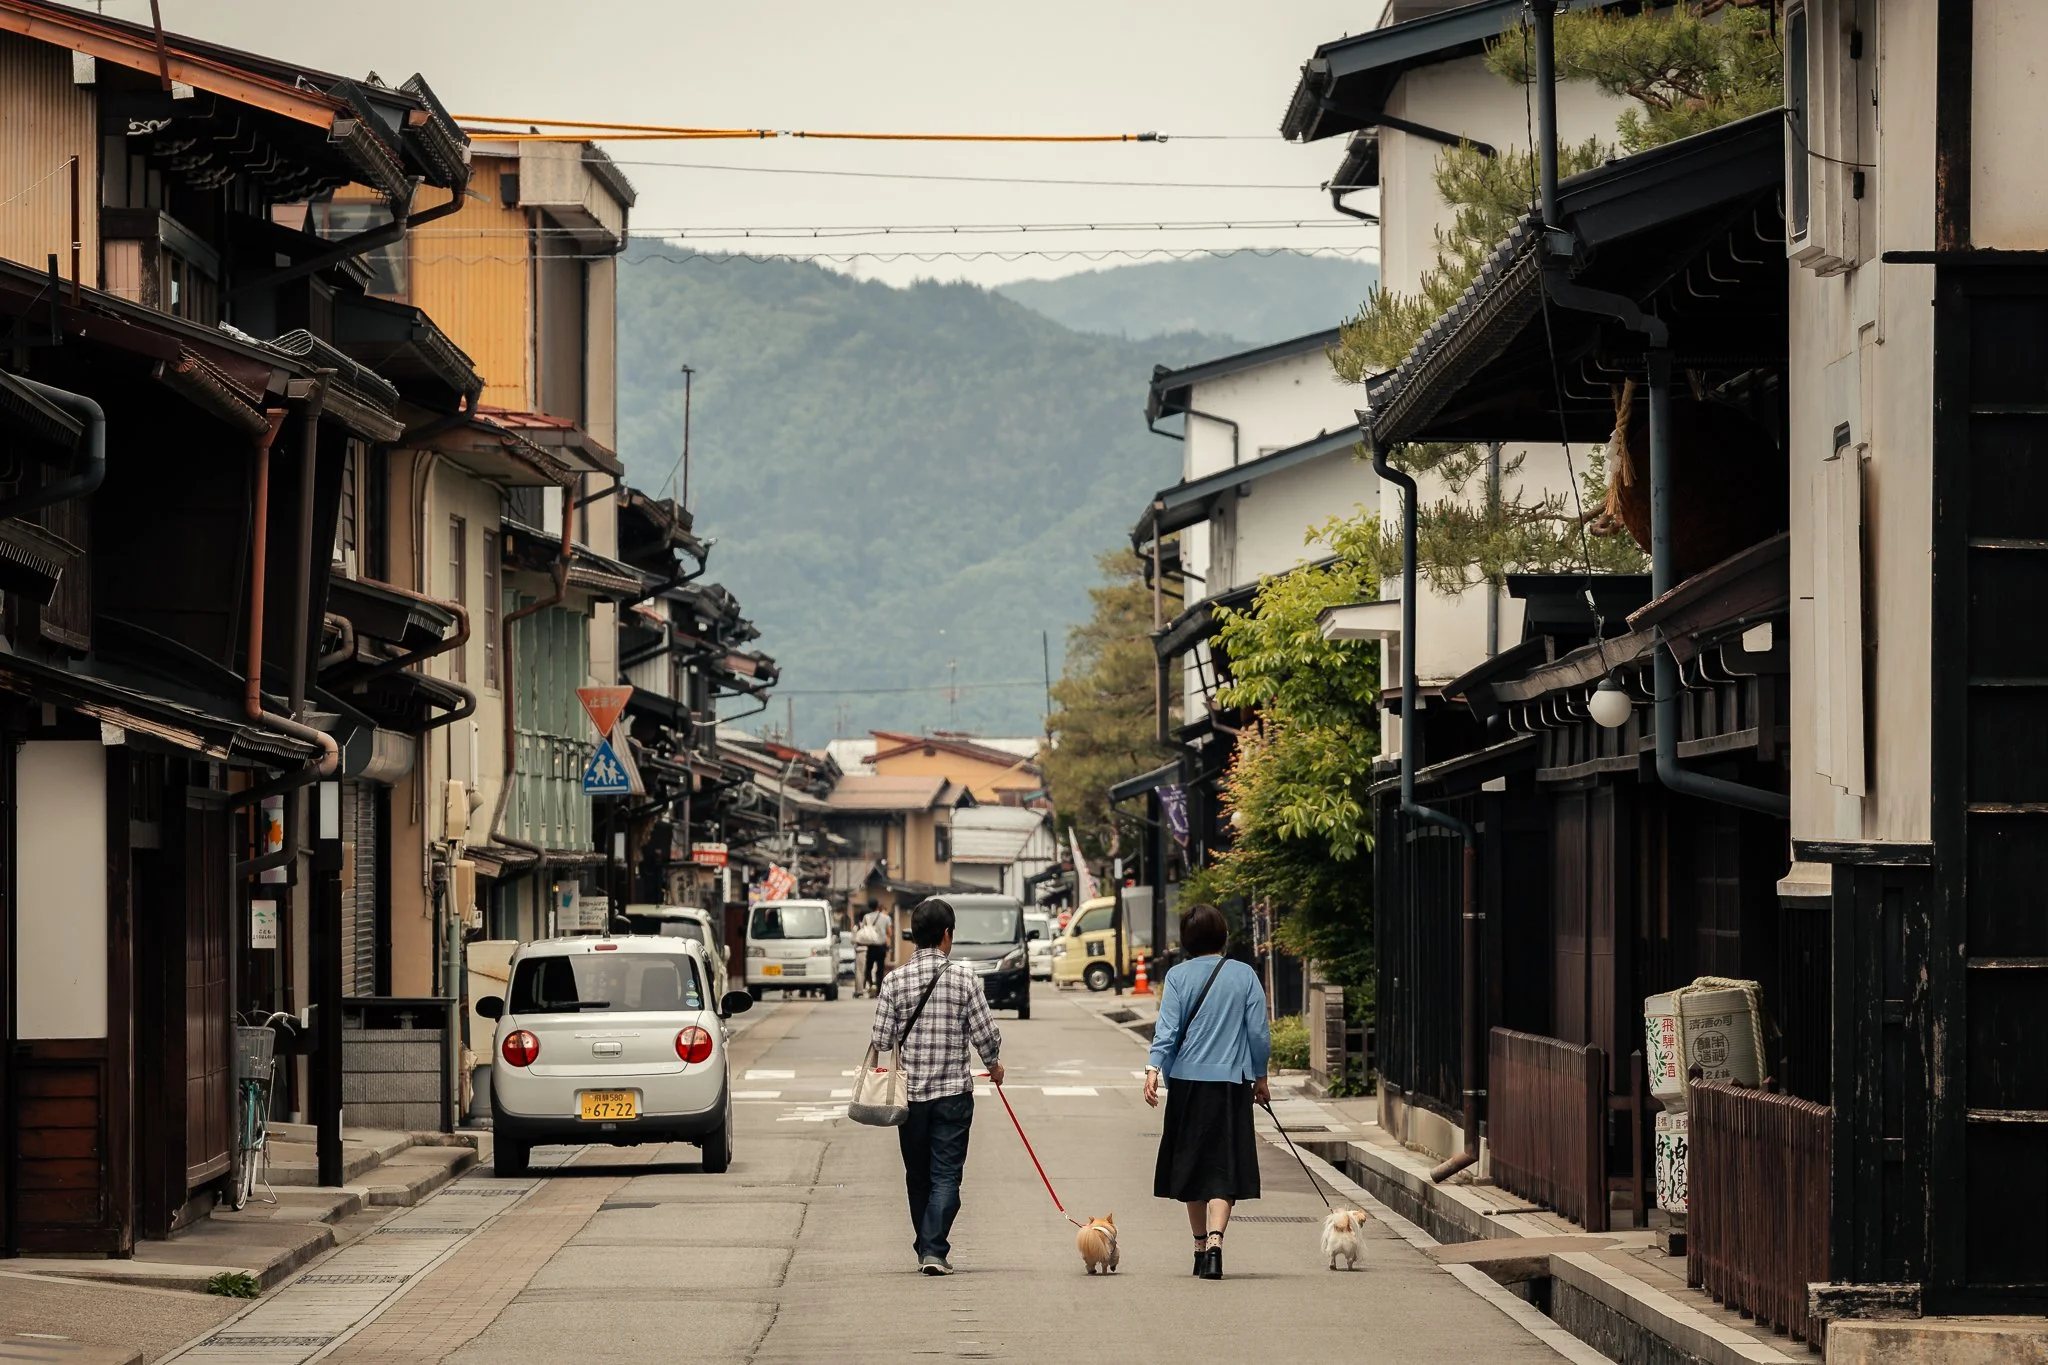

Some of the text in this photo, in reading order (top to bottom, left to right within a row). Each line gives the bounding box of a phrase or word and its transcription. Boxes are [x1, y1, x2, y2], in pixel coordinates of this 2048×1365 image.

[1662, 1018, 1676, 1078] 飛騨の酒
[610, 1093, 624, 1102] 580
[593, 1102, 633, 1117] 67-22
